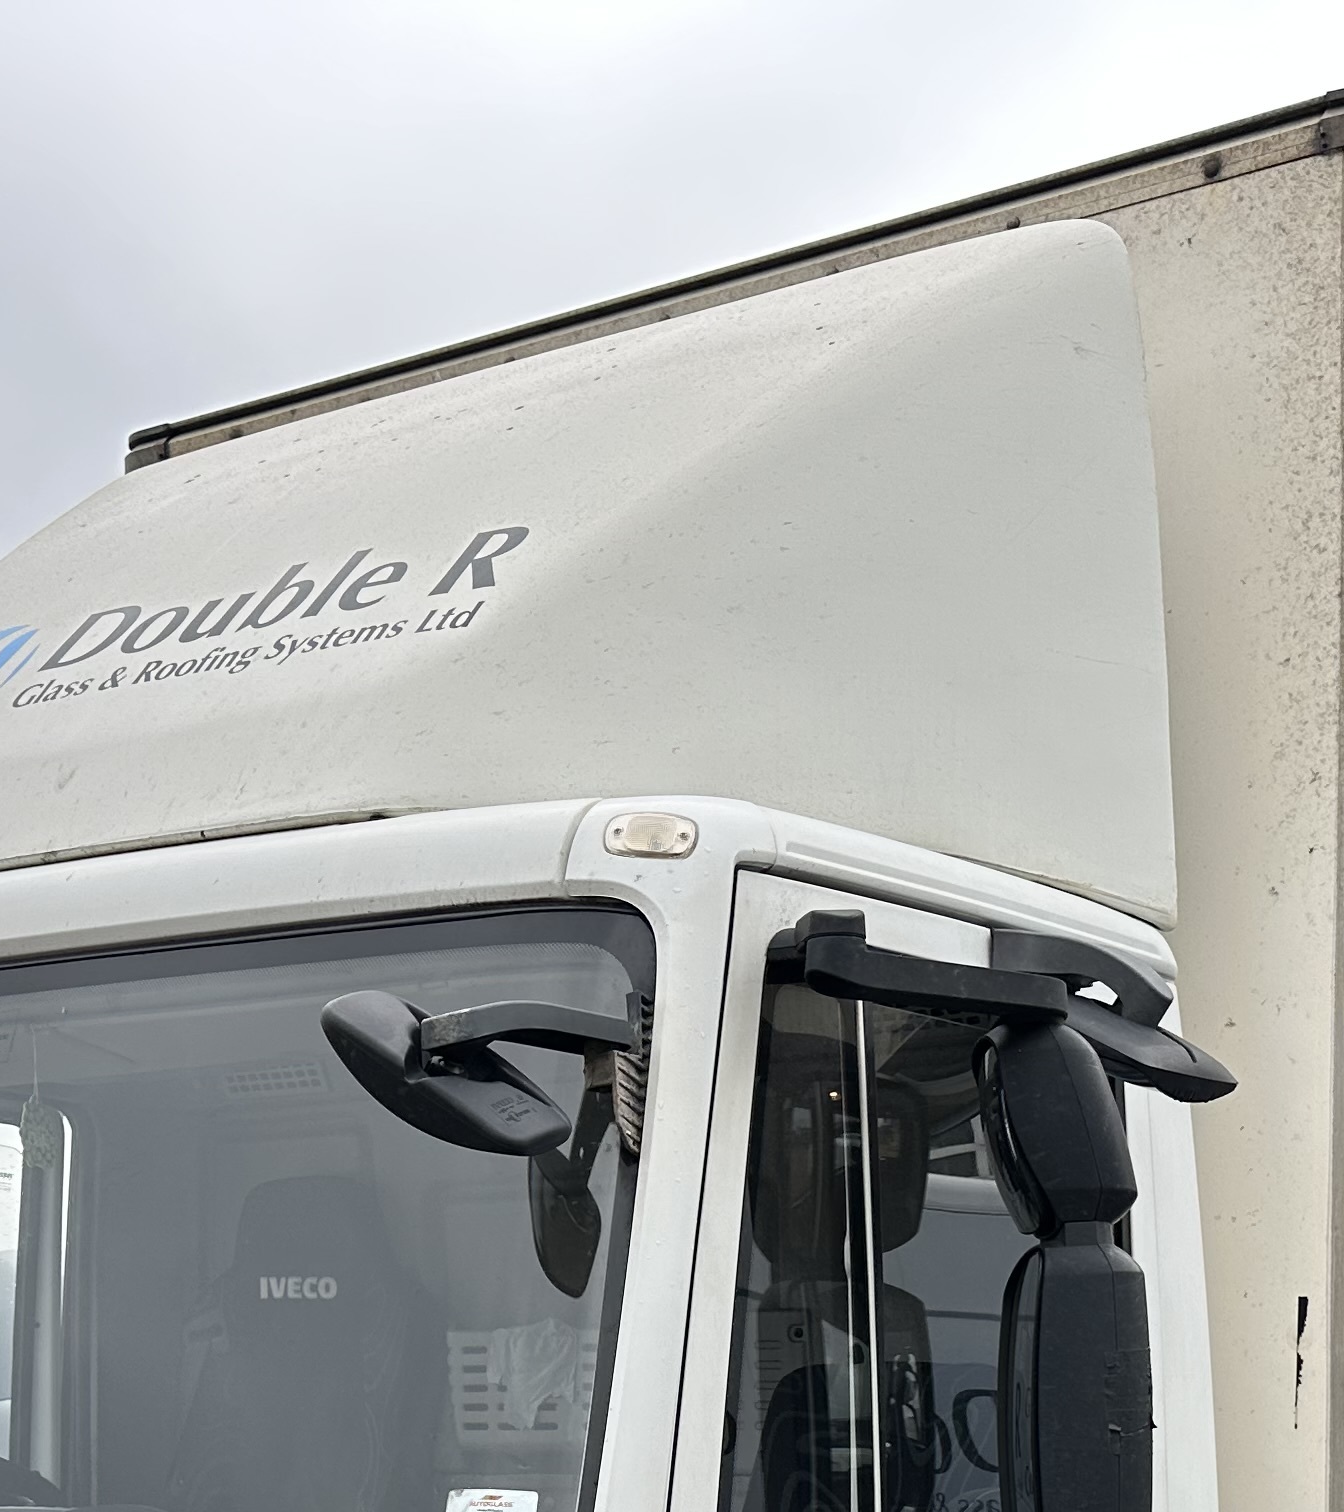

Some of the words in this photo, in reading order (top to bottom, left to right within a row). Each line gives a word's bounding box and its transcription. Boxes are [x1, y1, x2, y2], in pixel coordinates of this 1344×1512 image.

[38, 548, 408, 673] Double
[428, 526, 530, 597] R
[12, 673, 89, 709] Glass
[98, 666, 128, 688] &
[131, 644, 262, 684] Roofing
[264, 620, 409, 666] Systems
[415, 601, 485, 634] Ltd
[259, 1276, 338, 1300] IVECO
